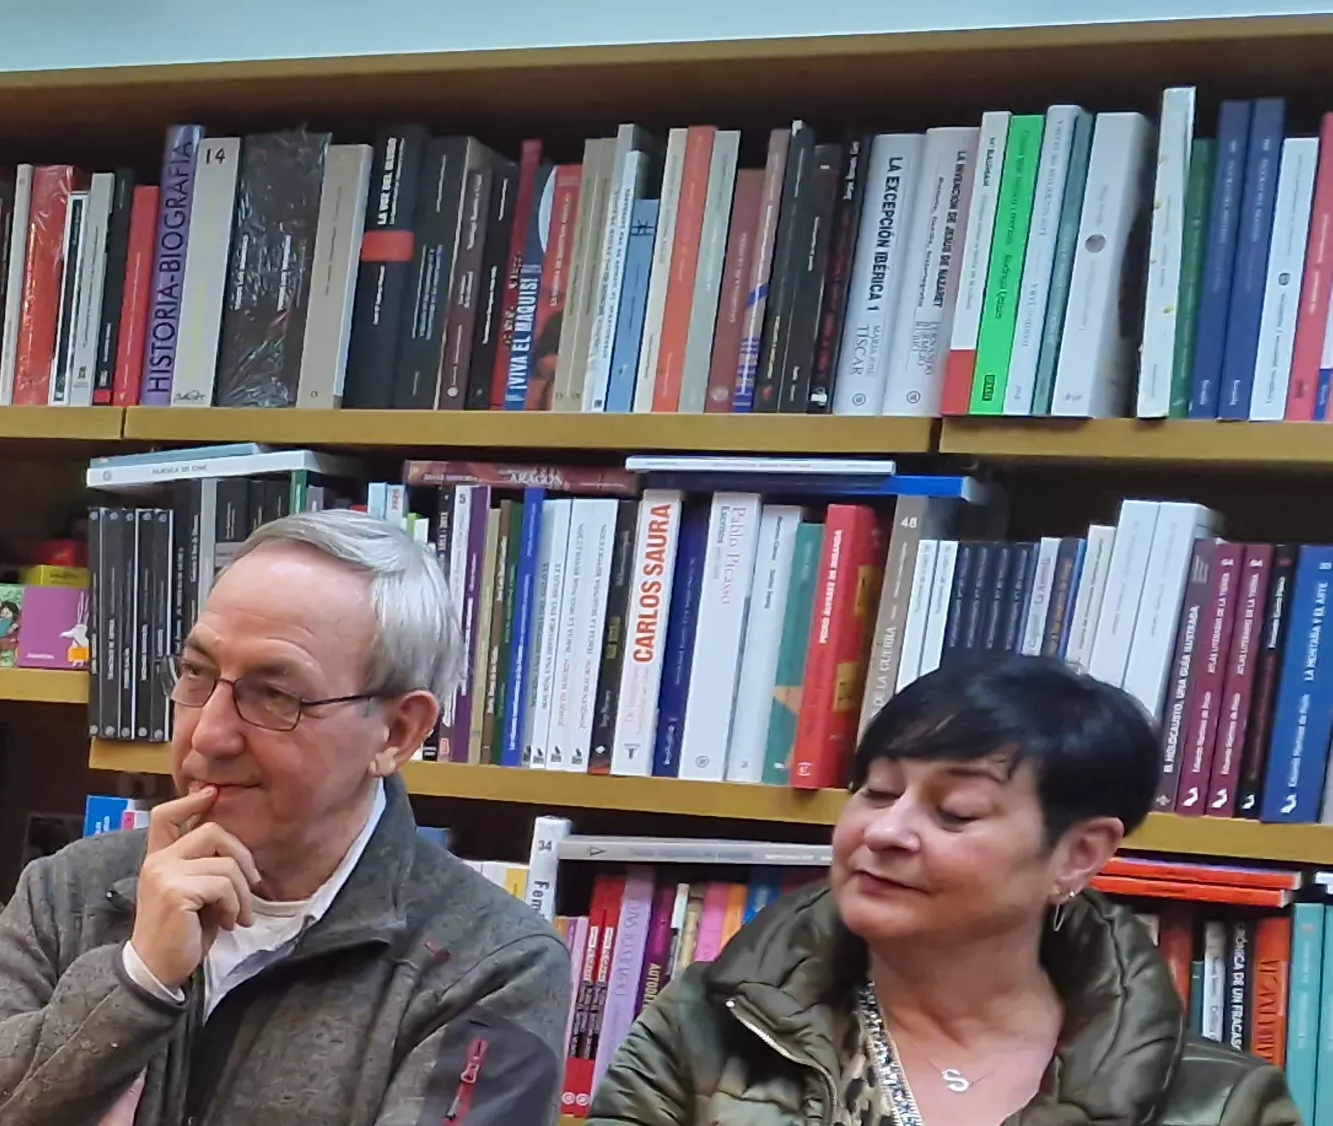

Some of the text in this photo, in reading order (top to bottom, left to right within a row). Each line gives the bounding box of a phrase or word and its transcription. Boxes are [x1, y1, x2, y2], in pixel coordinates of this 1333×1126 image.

[205, 148, 226, 165] 14
[887, 156, 904, 172] LA
[876, 175, 901, 248] EXCEPCIÓN
[869, 251, 889, 301] IBÉRICA
[512, 334, 531, 352] EL
[459, 493, 466, 505] 5
[715, 505, 730, 543] Escritos
[900, 516, 918, 528] 48
[721, 506, 747, 605] Pablo Picasso
[633, 504, 672, 664] CARLOS SAURA
[1318, 582, 1329, 605] ARTE
[820, 617, 831, 644] PEDRO
[879, 625, 897, 671] GUERRA
[1208, 653, 1218, 674] ATLAS
[1237, 654, 1247, 675] ATLAS
[538, 840, 552, 851] 34
[1233, 922, 1248, 1003] CRÓNICA DE UN
